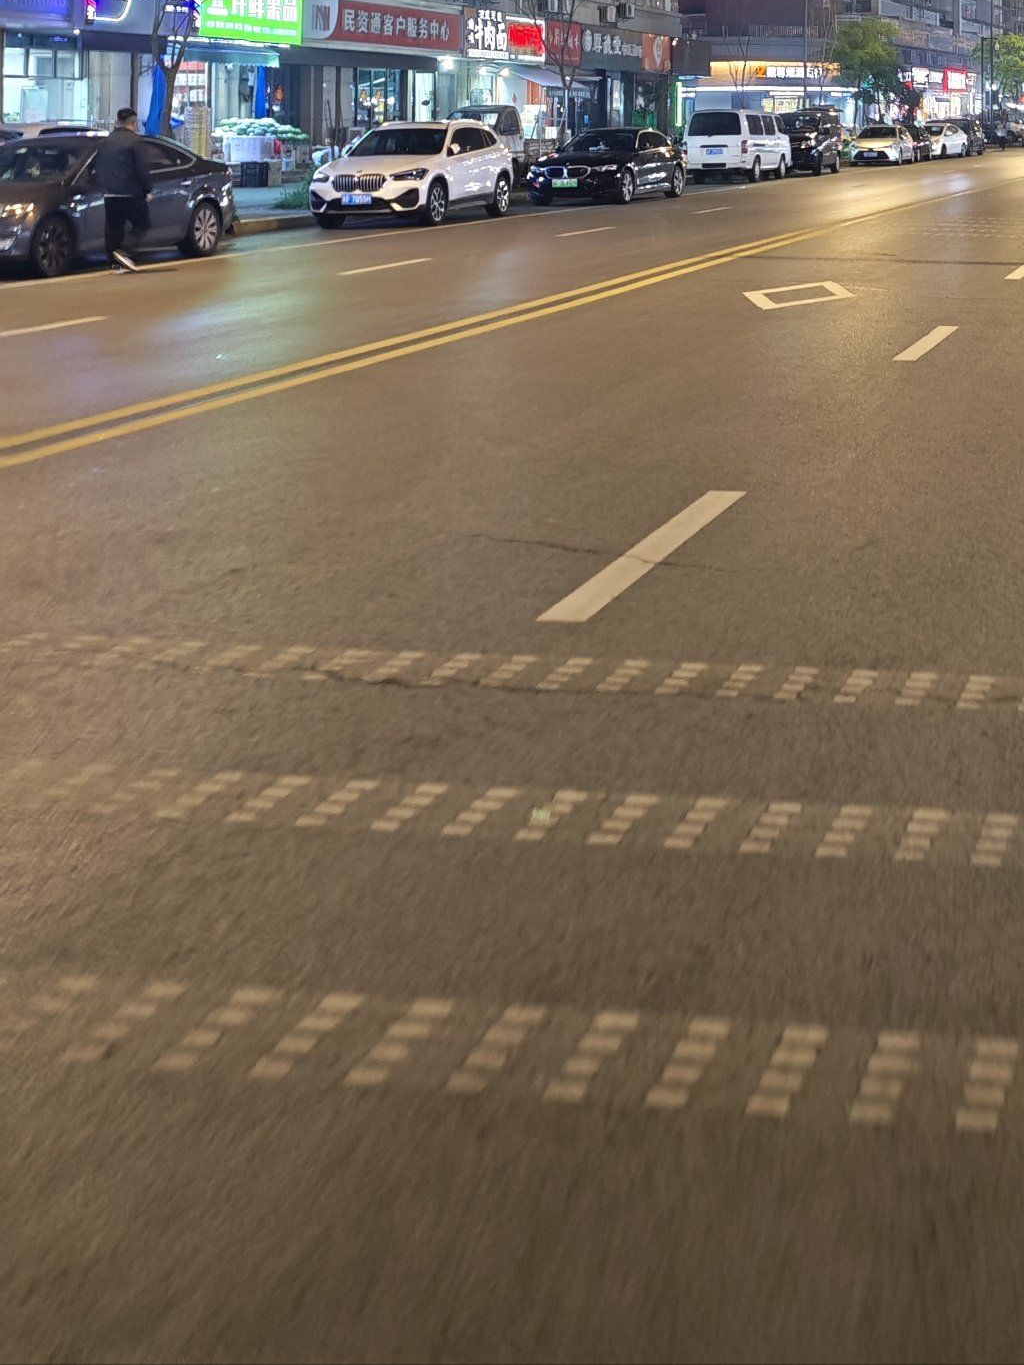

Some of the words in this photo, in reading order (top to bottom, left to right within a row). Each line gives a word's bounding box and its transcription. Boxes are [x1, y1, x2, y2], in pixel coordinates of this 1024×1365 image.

[343, 8, 450, 41] 民资通客户服务中心
